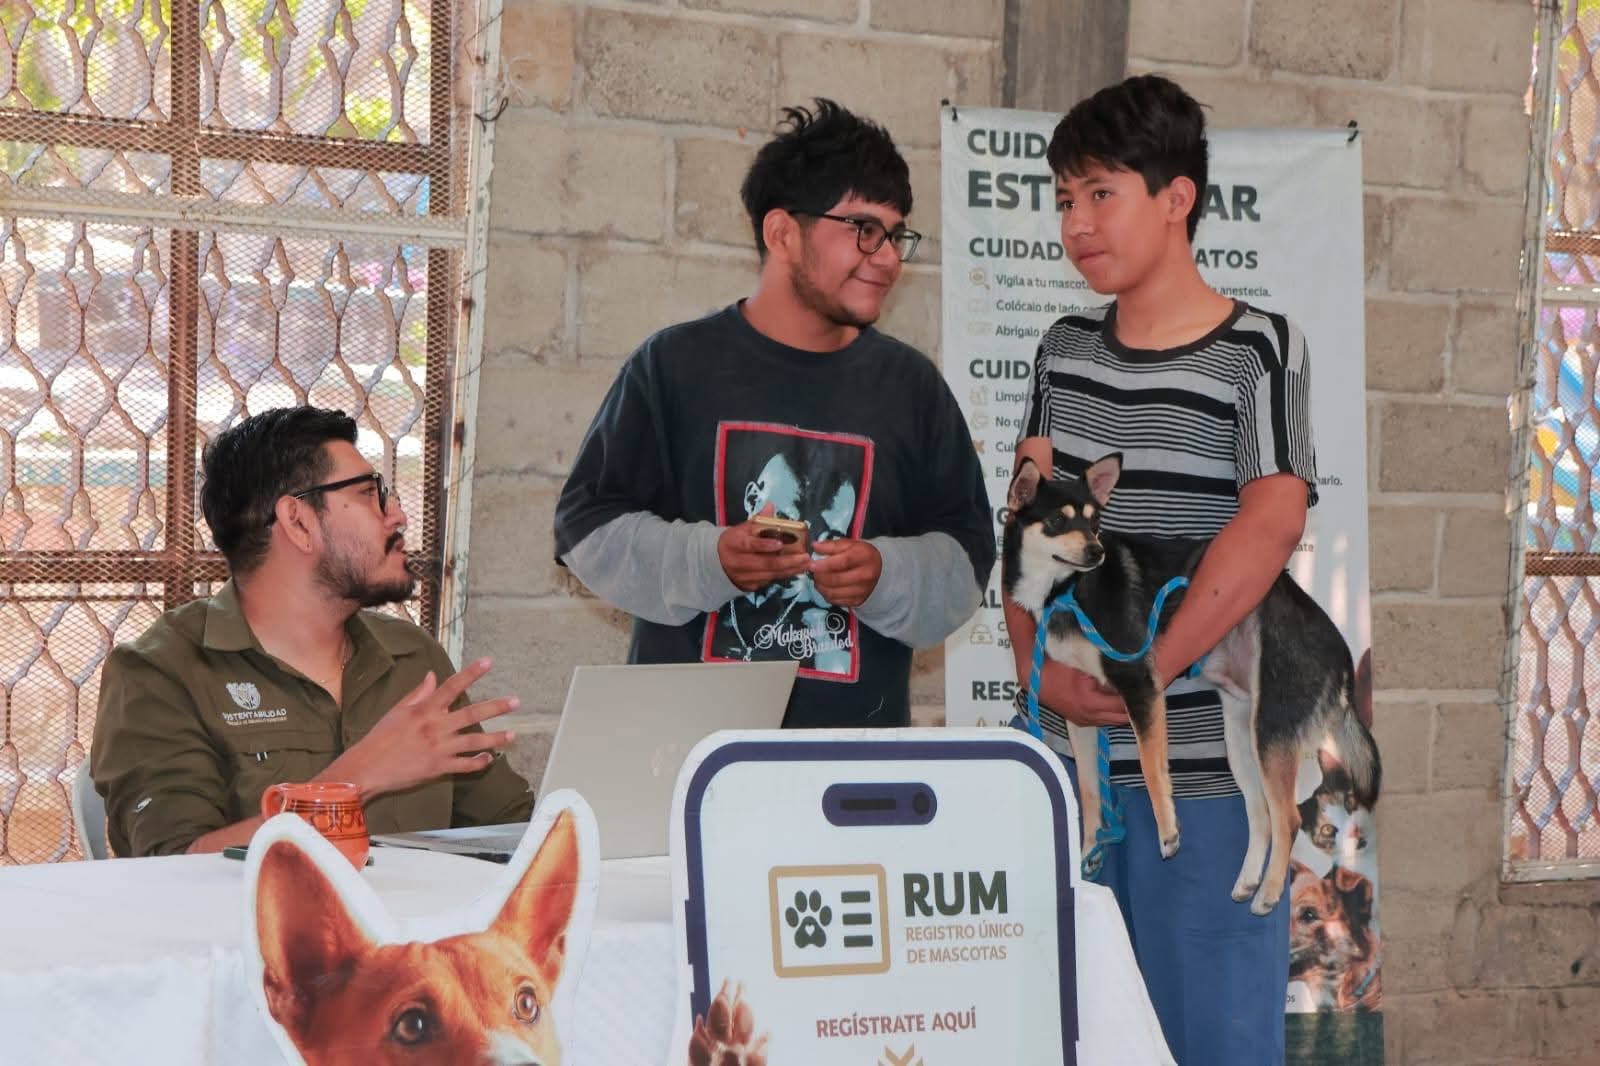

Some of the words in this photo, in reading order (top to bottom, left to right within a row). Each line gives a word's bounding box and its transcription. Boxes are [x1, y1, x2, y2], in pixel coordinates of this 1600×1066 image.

[967, 129, 1047, 159] CUID
[969, 237, 1064, 261] CUIDAD
[1195, 248, 1258, 270] ATOS
[995, 274, 1025, 288] Vigila
[1027, 279, 1034, 288] a
[1035, 279, 1046, 288] tu
[1043, 303, 1057, 313] de
[1059, 303, 1080, 314] lado
[969, 359, 1031, 380] CUID
[995, 391, 1026, 405] Limpi
[995, 416, 1011, 428] No
[995, 441, 1015, 453] Cui
[996, 468, 1009, 478] En
[972, 680, 1017, 701] RES
[903, 871, 1008, 917] RUM
[906, 925, 975, 942] REGISTRO
[979, 920, 1024, 939] ÚNICO
[907, 949, 926, 964] DE
[929, 945, 1007, 963] MASCOTAS
[816, 1011, 926, 1038] REGÍSTRATE
[932, 1005, 977, 1032] AQUÍ
